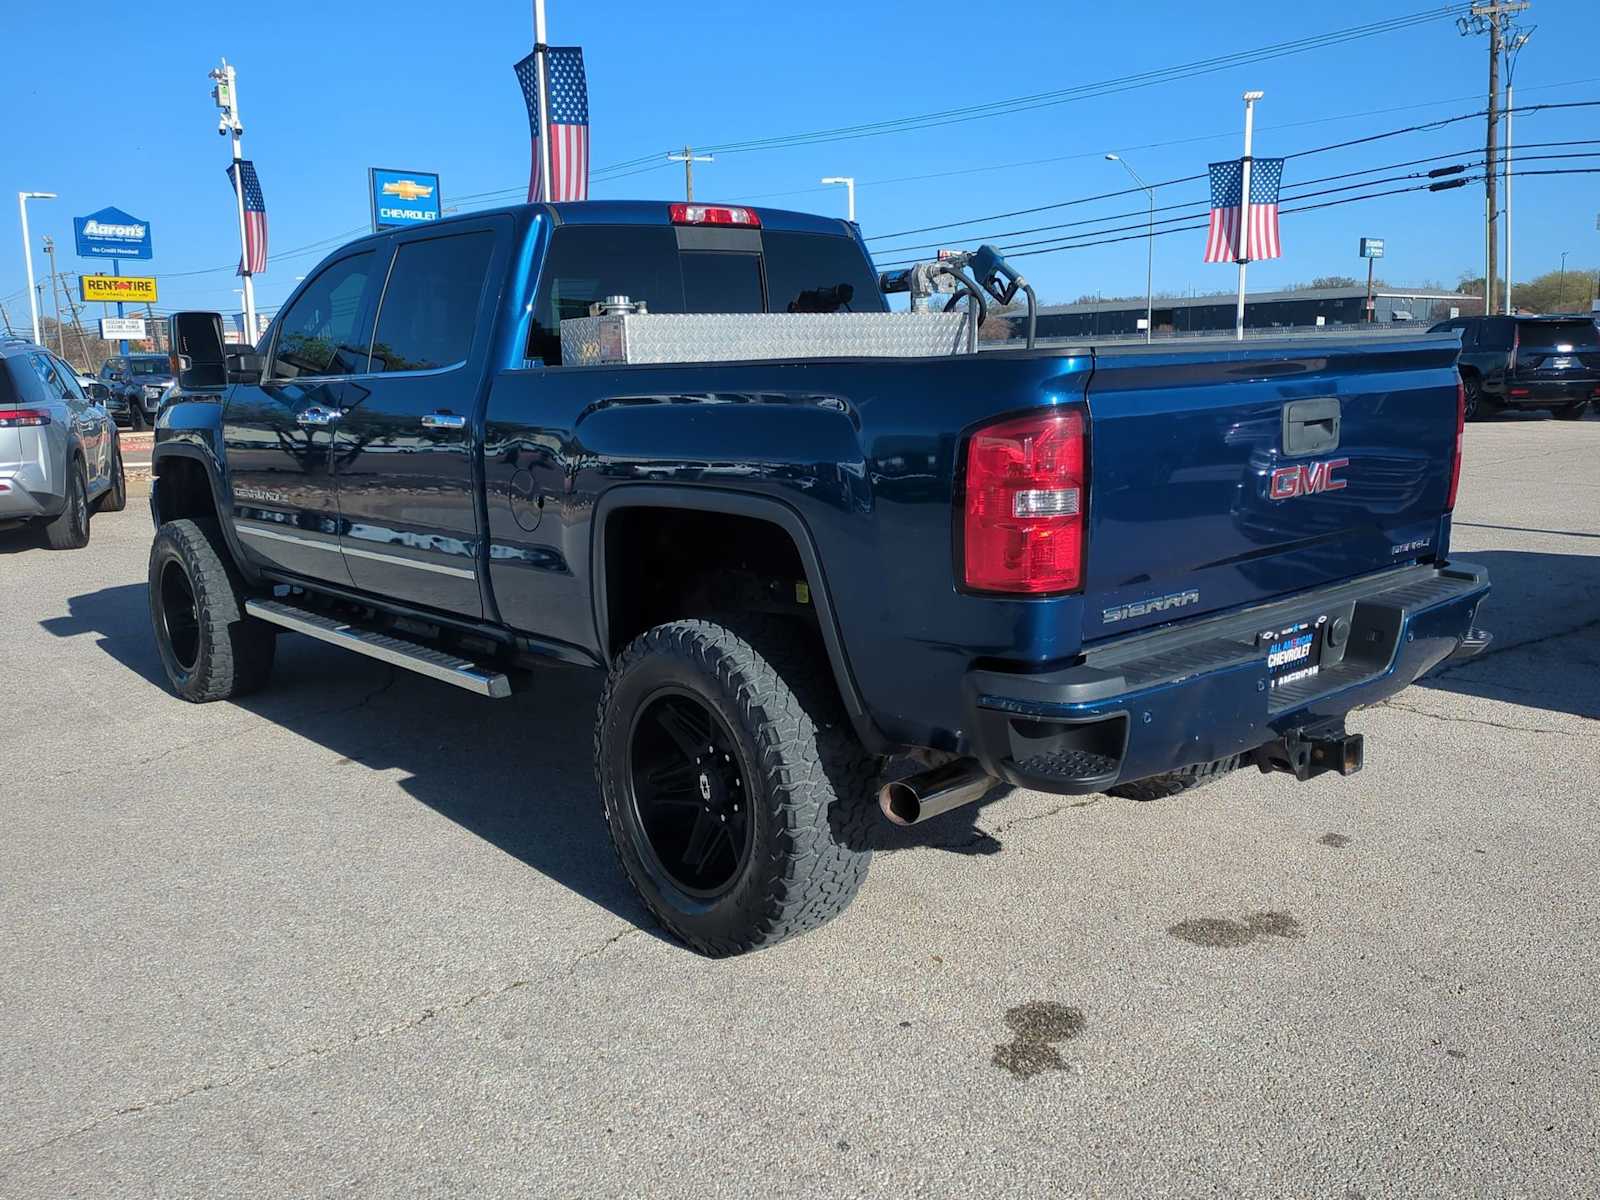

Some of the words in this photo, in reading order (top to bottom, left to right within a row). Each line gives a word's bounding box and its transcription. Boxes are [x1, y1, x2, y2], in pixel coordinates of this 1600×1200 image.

[380, 208, 436, 221] CHEVROLET
[84, 219, 145, 239] Aaron's
[1269, 457, 1349, 500] GMC
[1103, 589, 1199, 624] SIERRA
[1269, 643, 1282, 654] ALL
[1282, 633, 1314, 651] AMERICAN
[1268, 643, 1312, 668] CHEVROLET
